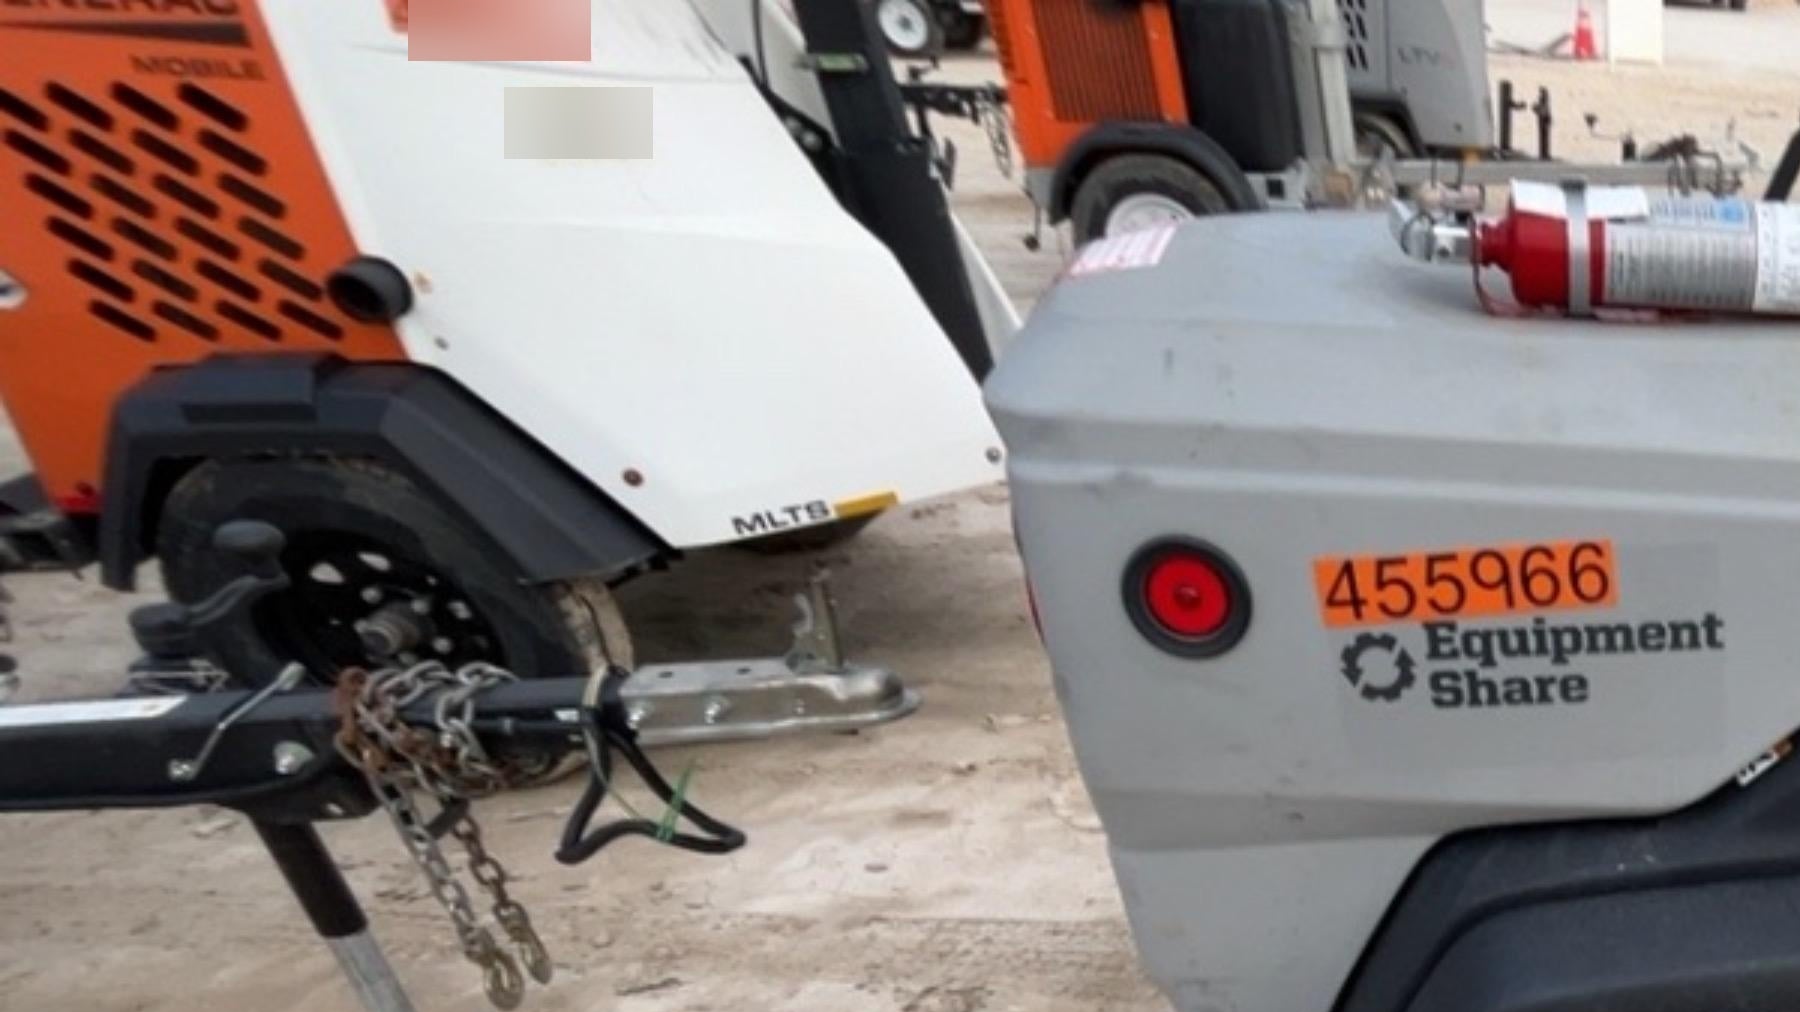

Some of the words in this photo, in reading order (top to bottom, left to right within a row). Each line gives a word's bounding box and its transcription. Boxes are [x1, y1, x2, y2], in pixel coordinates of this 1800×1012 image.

[129, 54, 266, 80] MOBILE
[1325, 542, 1612, 620] 455966
[1422, 612, 1726, 667] Equipment
[1428, 669, 1590, 709] Share
